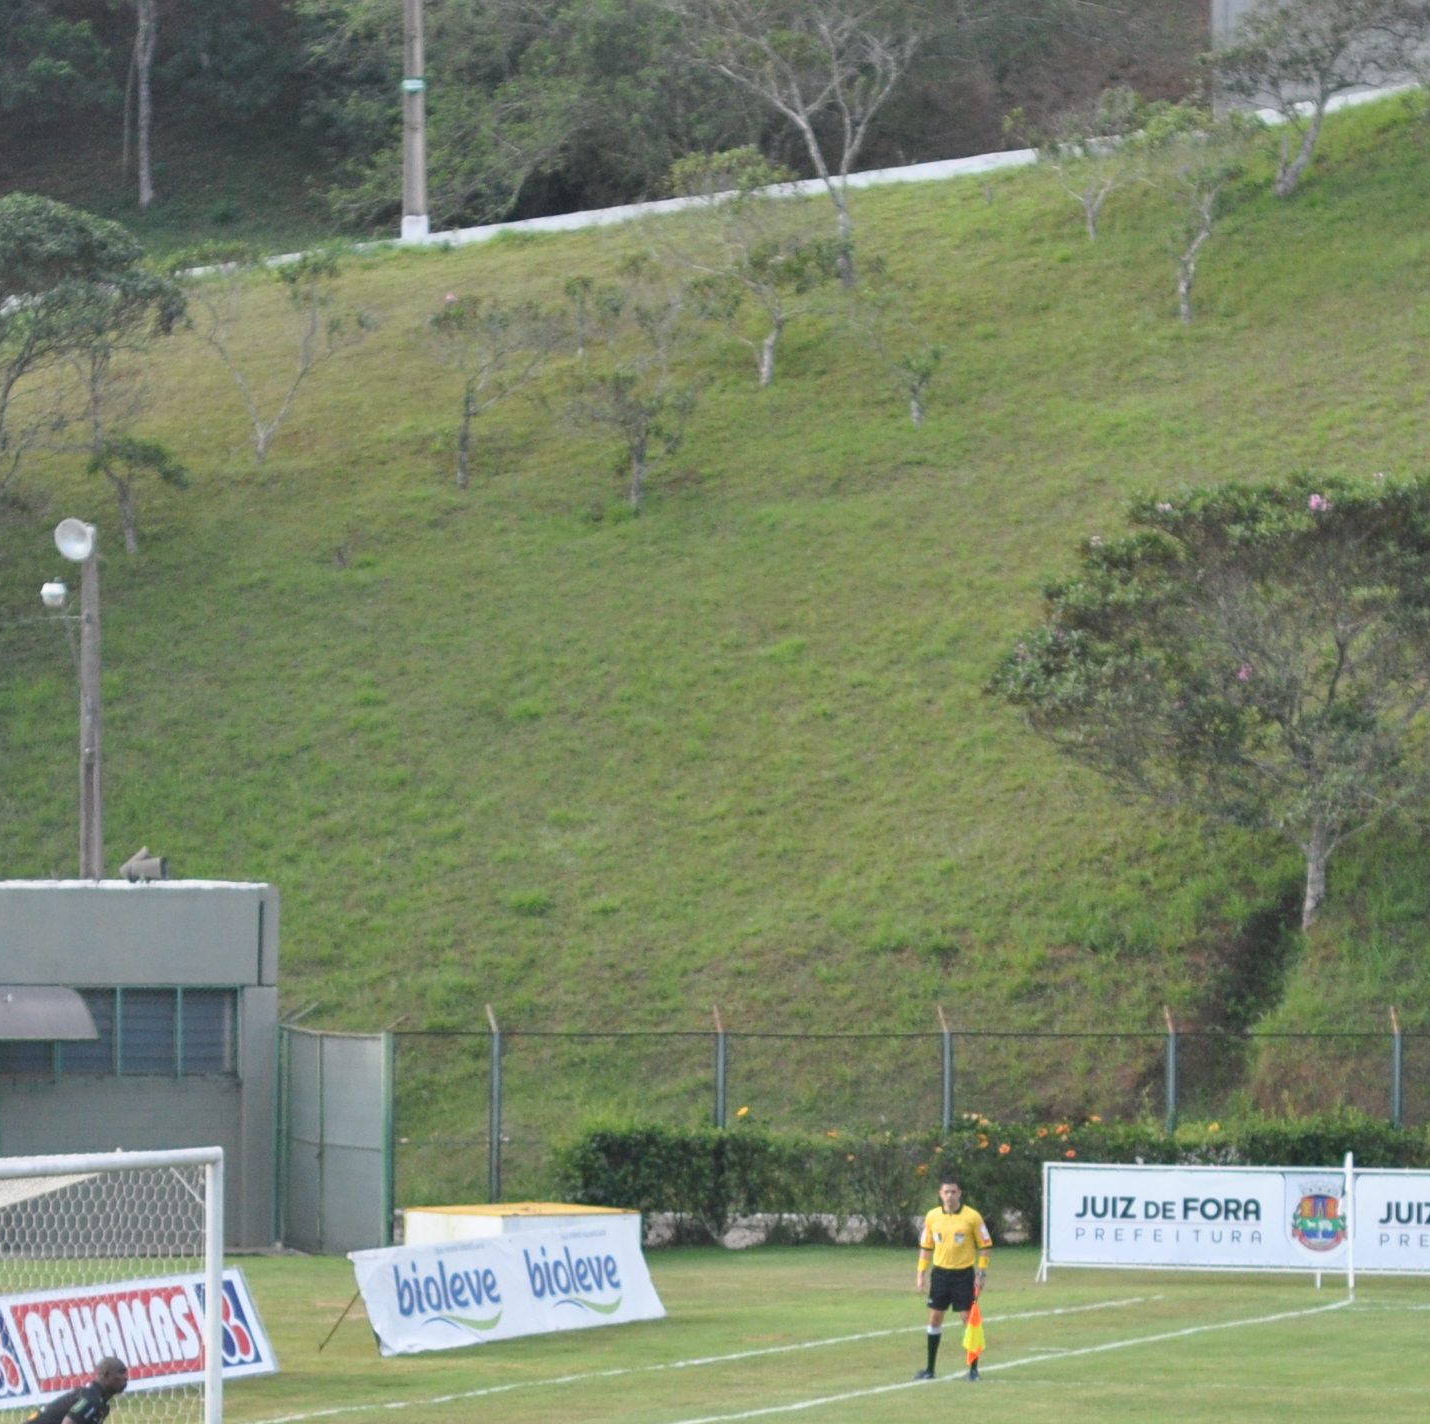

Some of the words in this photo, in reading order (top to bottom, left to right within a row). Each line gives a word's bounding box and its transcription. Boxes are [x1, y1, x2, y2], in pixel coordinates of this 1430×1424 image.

[1075, 1195, 1136, 1219] JUIZ
[1144, 1201, 1176, 1220] DE
[1183, 1197, 1262, 1221] FORA
[1075, 1227, 1262, 1244] PREFEITURA
[393, 1259, 501, 1317] bioleve
[524, 1245, 622, 1299] bioleve
[25, 1294, 200, 1380] BAHAMAS
